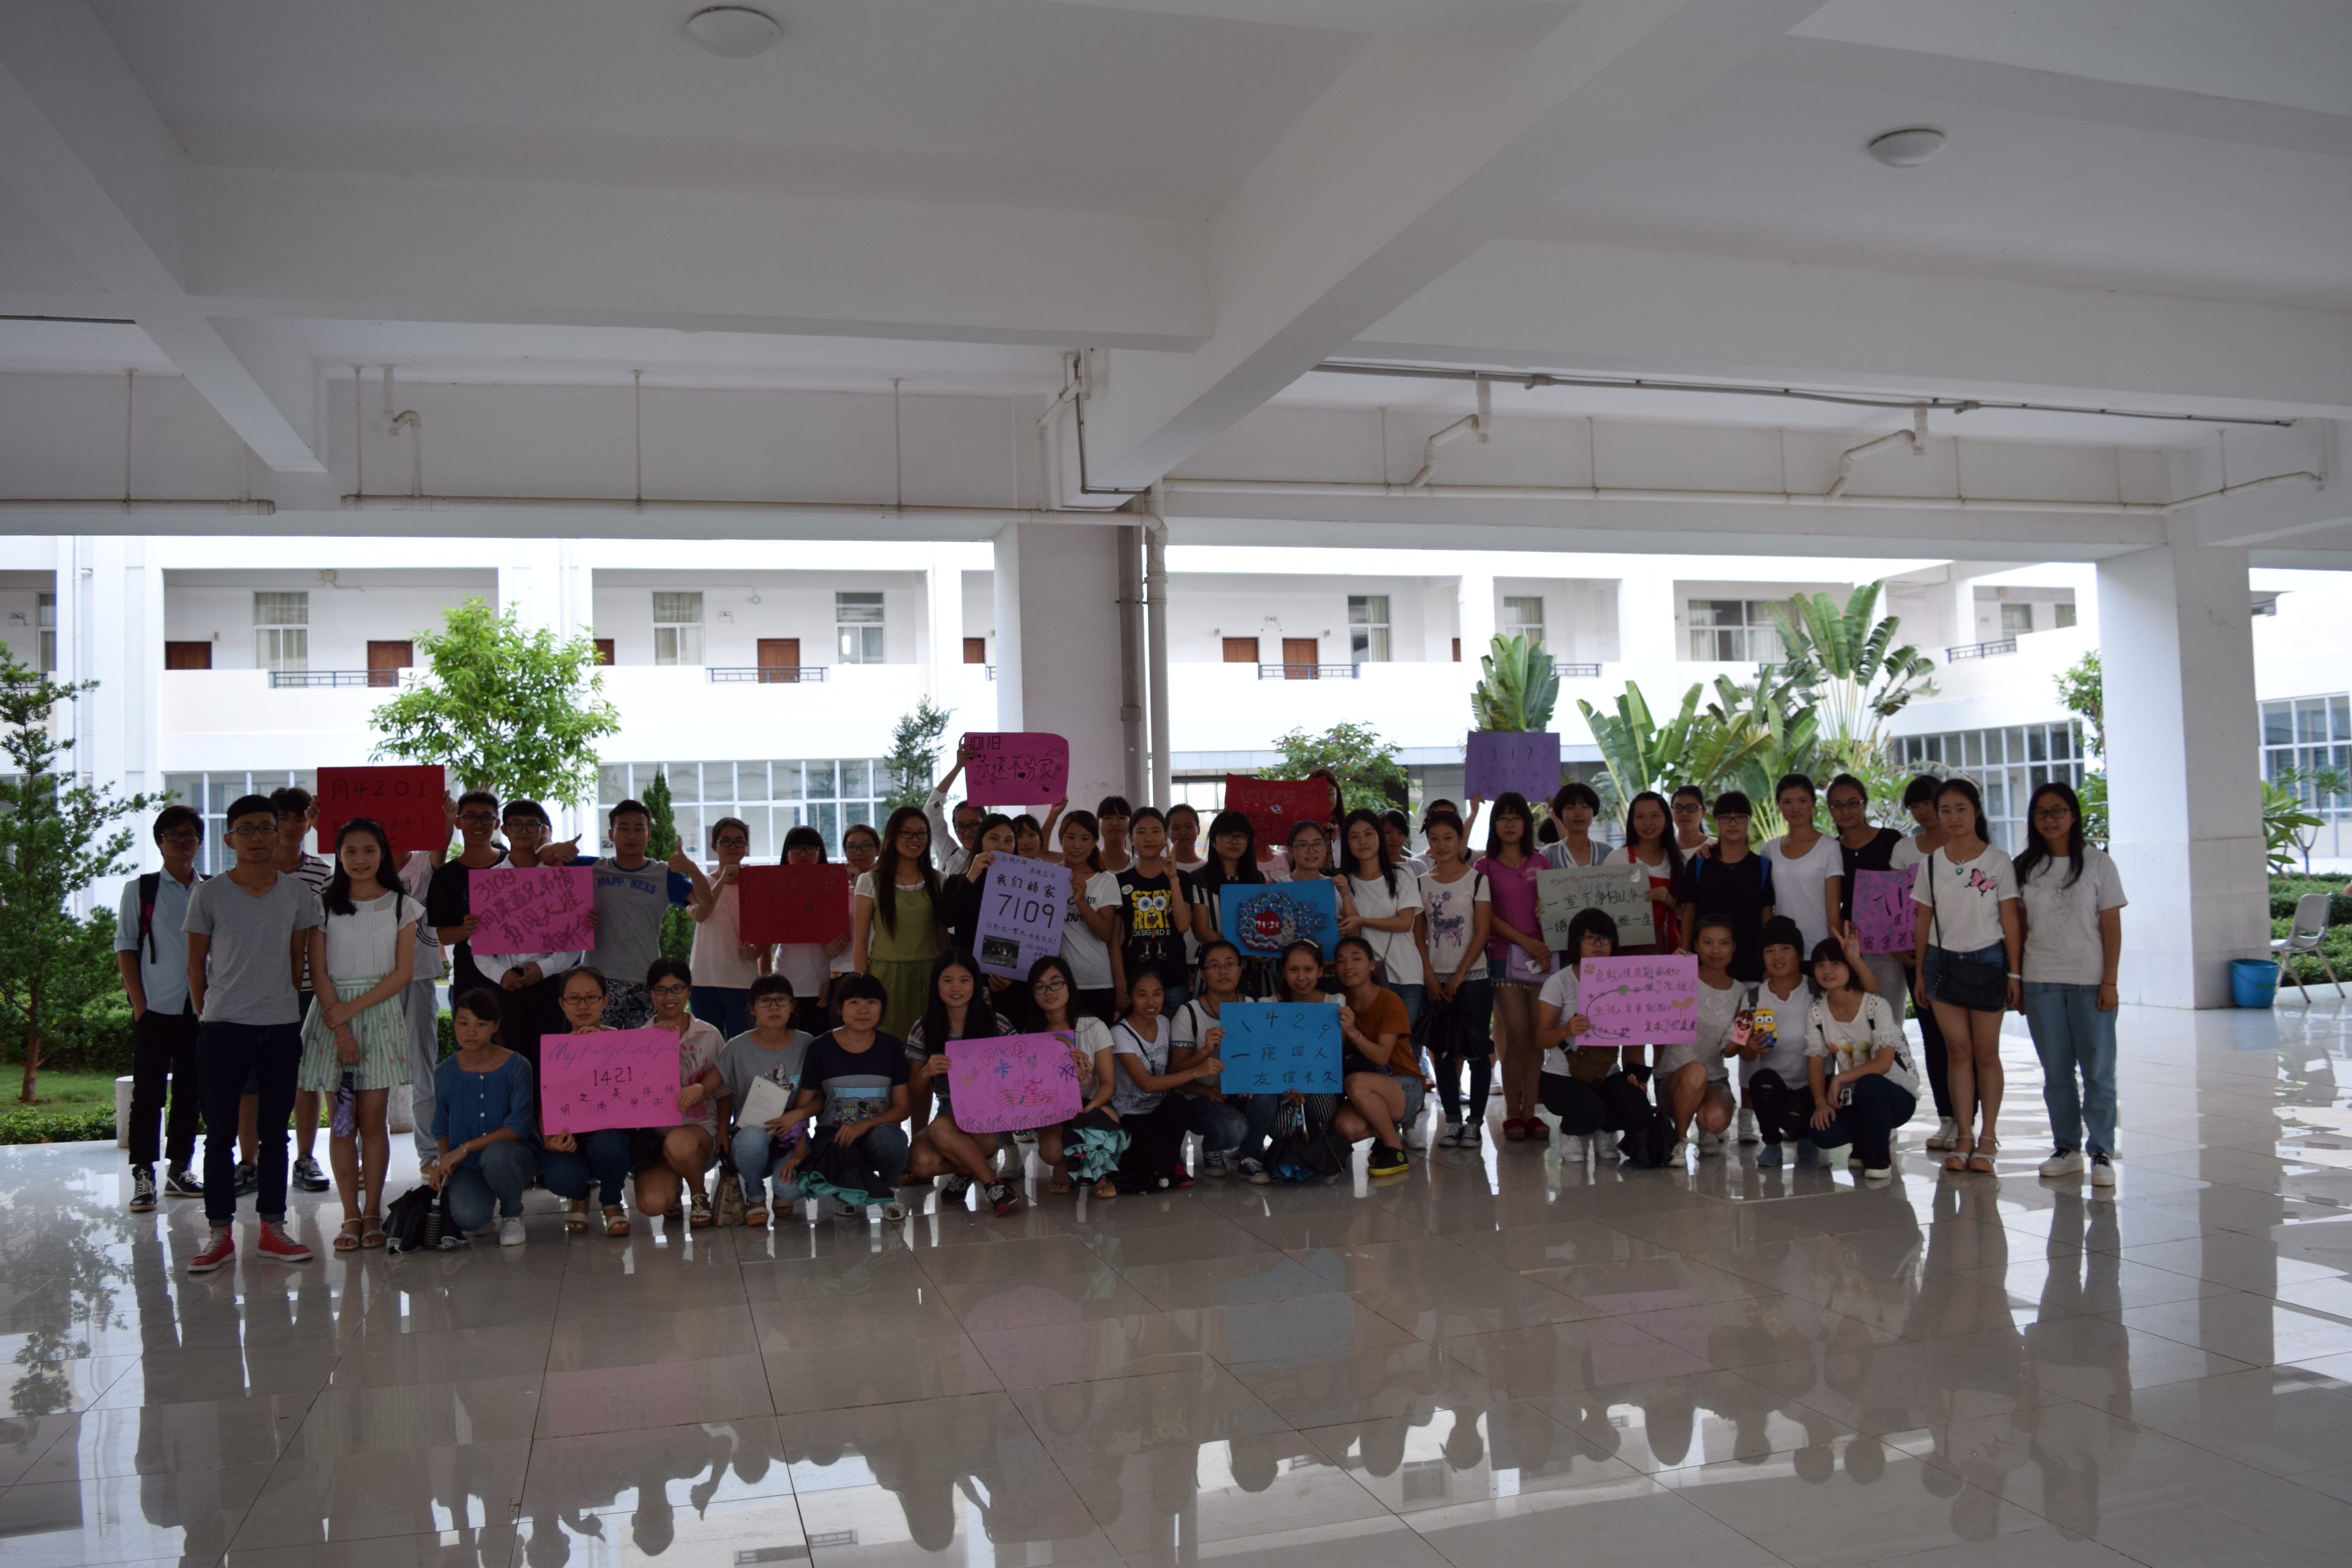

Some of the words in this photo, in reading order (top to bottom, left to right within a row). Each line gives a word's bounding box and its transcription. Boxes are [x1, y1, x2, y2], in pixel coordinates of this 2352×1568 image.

[997, 873, 1056, 898] 我们的家
[998, 893, 1055, 929] 7109
[1230, 1044, 1328, 1062] 一寝四人
[593, 1066, 633, 1087] 1421
[1254, 1069, 1338, 1087] 友谊长久
